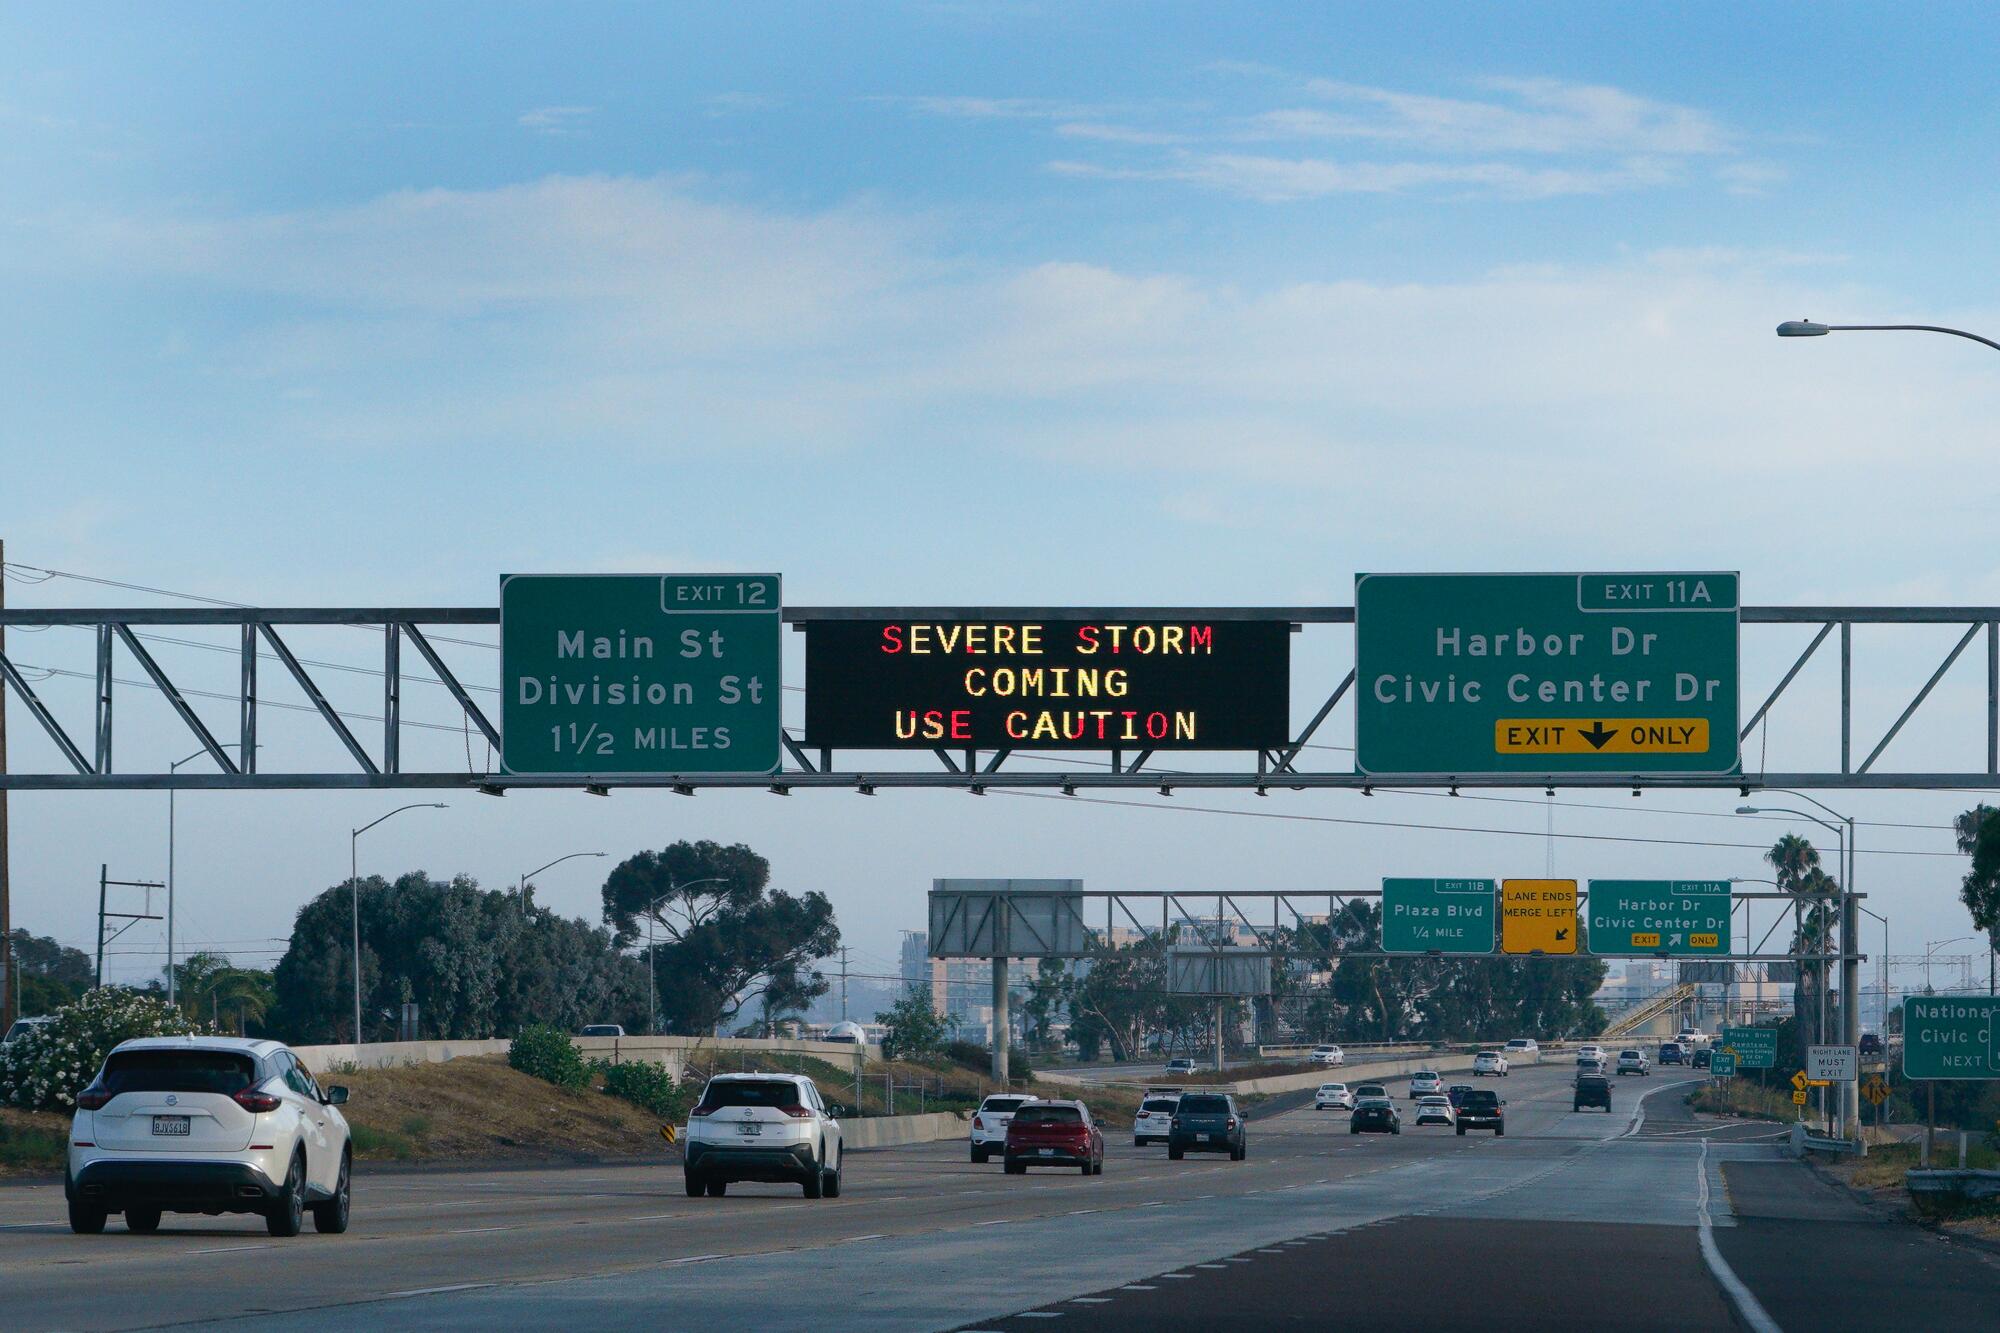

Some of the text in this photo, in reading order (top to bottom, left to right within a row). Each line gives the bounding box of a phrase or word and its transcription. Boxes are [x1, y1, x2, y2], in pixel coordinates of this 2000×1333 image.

[677, 582, 766, 604] EXIT 12
[1605, 581, 1712, 603] EXIT 11A
[557, 628, 725, 659] Main St
[881, 625, 1213, 655] SEVERE STORM
[1436, 626, 1657, 656] Harbor Dr
[963, 667, 1129, 697] COMING
[1374, 673, 1721, 703] Civic Center Dr
[519, 674, 763, 705] Division St
[894, 710, 1196, 740] USE CAUTION
[634, 727, 731, 750] MILES
[1507, 726, 1696, 746] EXIT ONLY
[1468, 881, 1485, 891] 11B
[1703, 883, 1721, 892] 11A
[1507, 892, 1572, 901] LANE ENDS
[1394, 904, 1483, 917] Plaza Blvd
[1619, 899, 1701, 911] Harbor Dr
[1504, 908, 1575, 917] MERGE LEFT
[1594, 917, 1725, 929] Civic Center Dr
[1435, 928, 1464, 937] MILE
[1634, 936, 1717, 944] EXIT ONLY
[1915, 1004, 1996, 1018] Nationa
[1920, 1029, 1968, 1043] Civic
[1942, 1055, 1982, 1067] NEXT
[1820, 1069, 1843, 1077] EXIT
